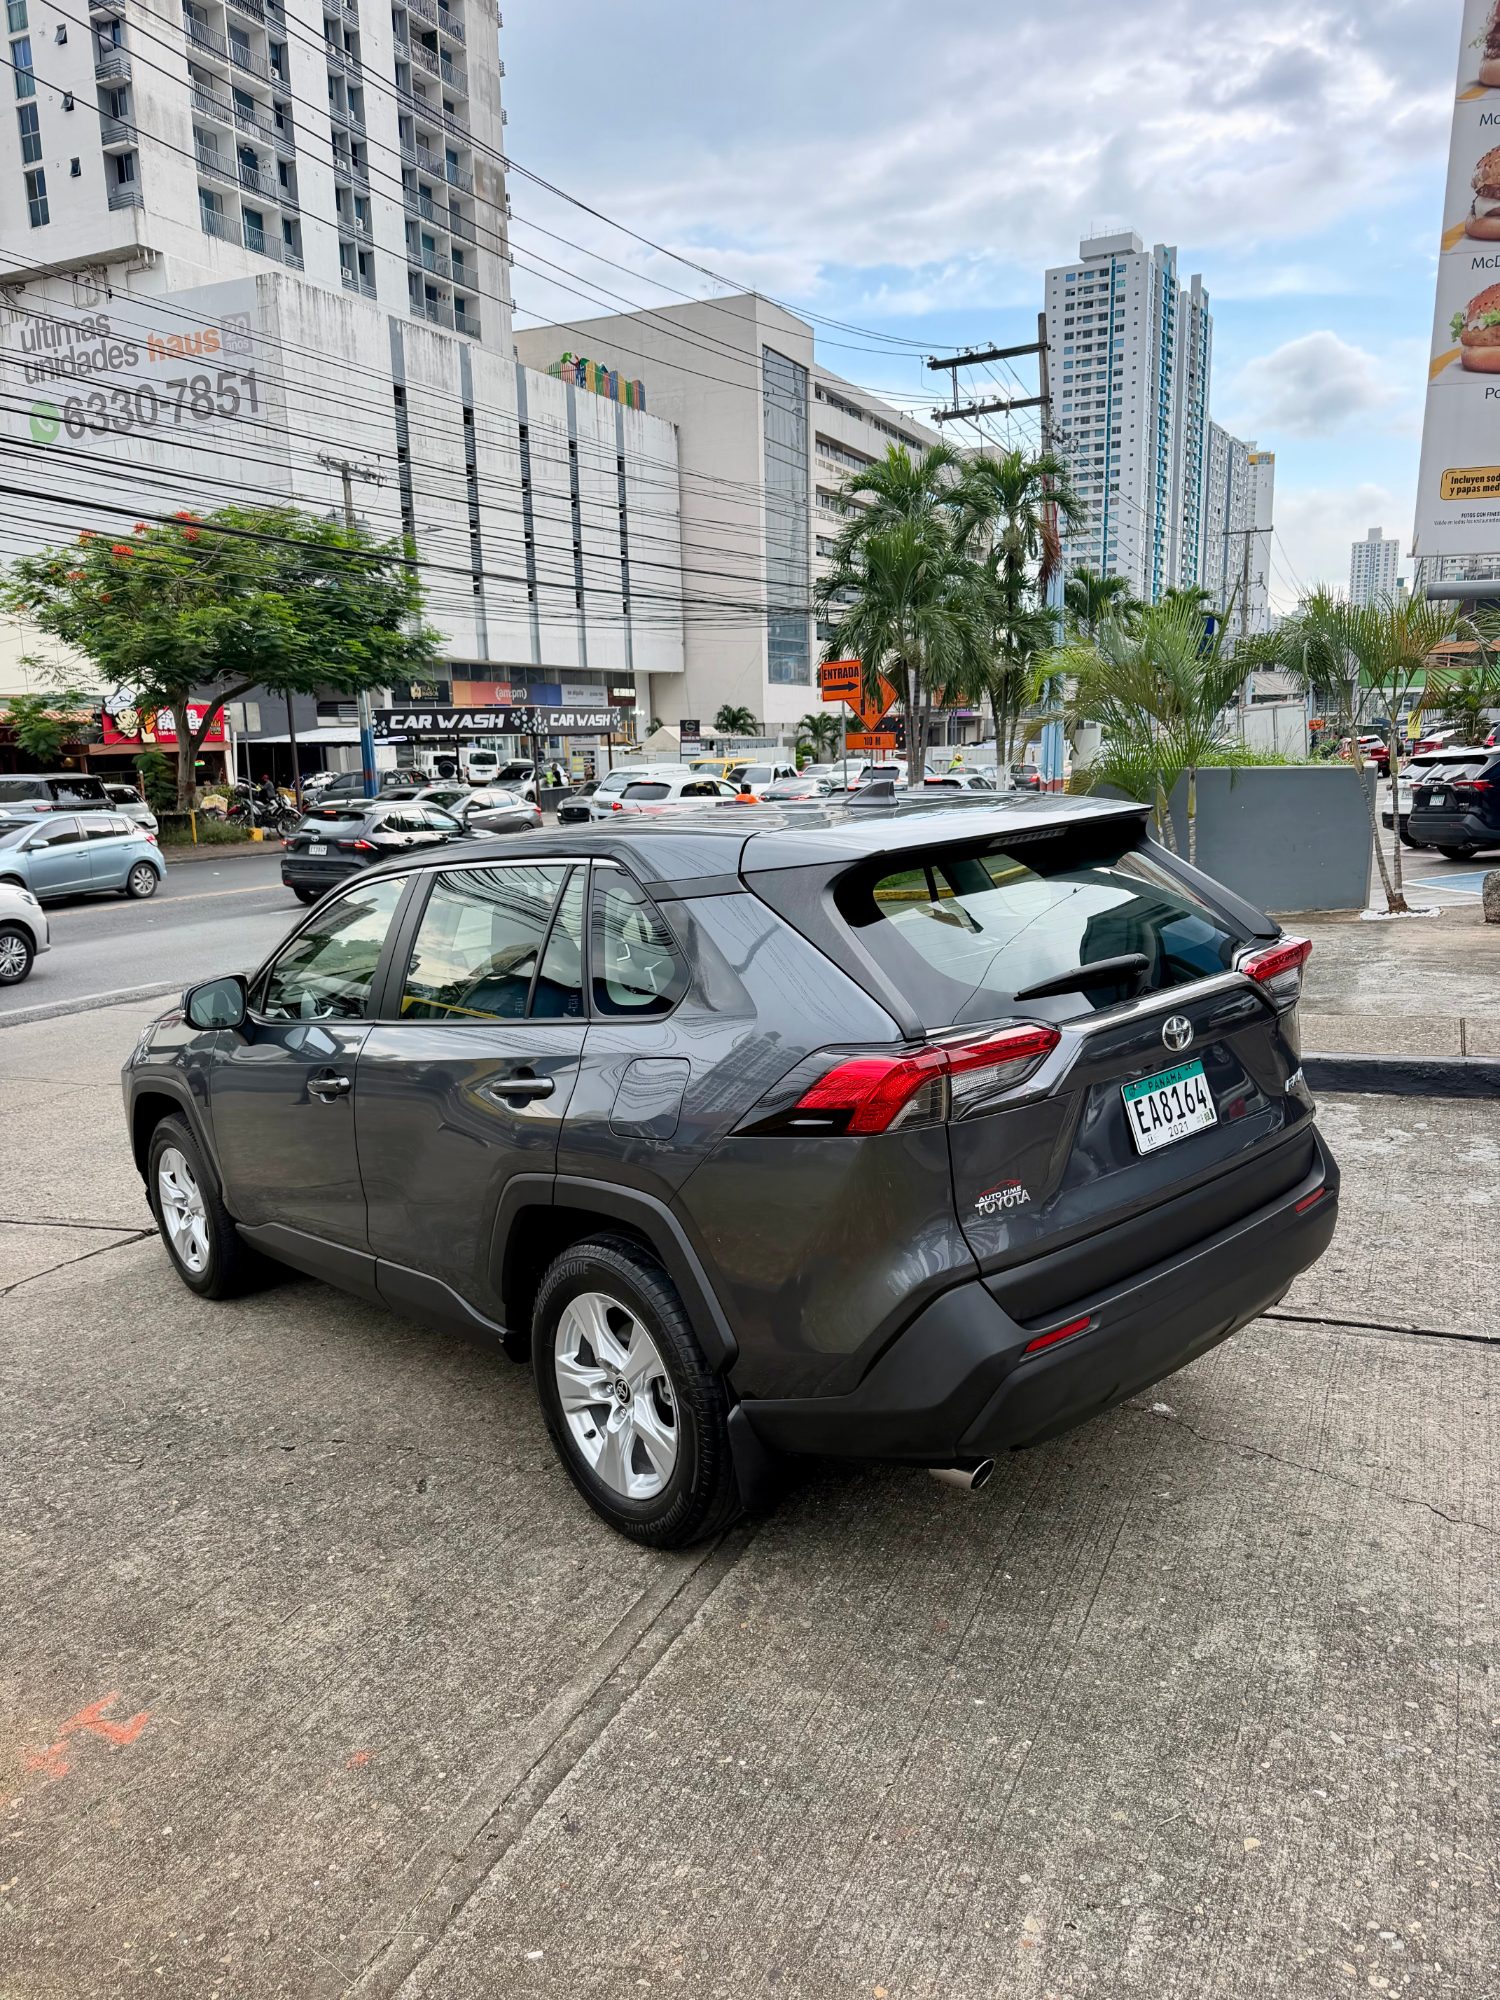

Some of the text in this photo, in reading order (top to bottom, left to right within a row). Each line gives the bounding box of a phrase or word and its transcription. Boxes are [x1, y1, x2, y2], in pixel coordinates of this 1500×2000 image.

[20, 314, 111, 353] últimas
[147, 328, 221, 363] haus
[24, 339, 139, 384] unidades
[64, 367, 259, 439] 6330-7851
[1451, 475, 1484, 486] Incluyen
[1449, 487, 1455, 497] y
[1456, 486, 1481, 496] papas
[823, 666, 860, 681] ENTRADA
[389, 713, 504, 730] CAR WASH
[549, 713, 610, 727] CAR WASH
[1148, 1071, 1183, 1092] PANAMA
[1133, 1077, 1207, 1134] EA8164
[1168, 1121, 1189, 1138] 2021
[974, 1189, 1031, 1216] TOYOTA
[978, 1185, 1022, 1204] AUTO TIME
[537, 1261, 590, 1315] BRIDGESTONE
